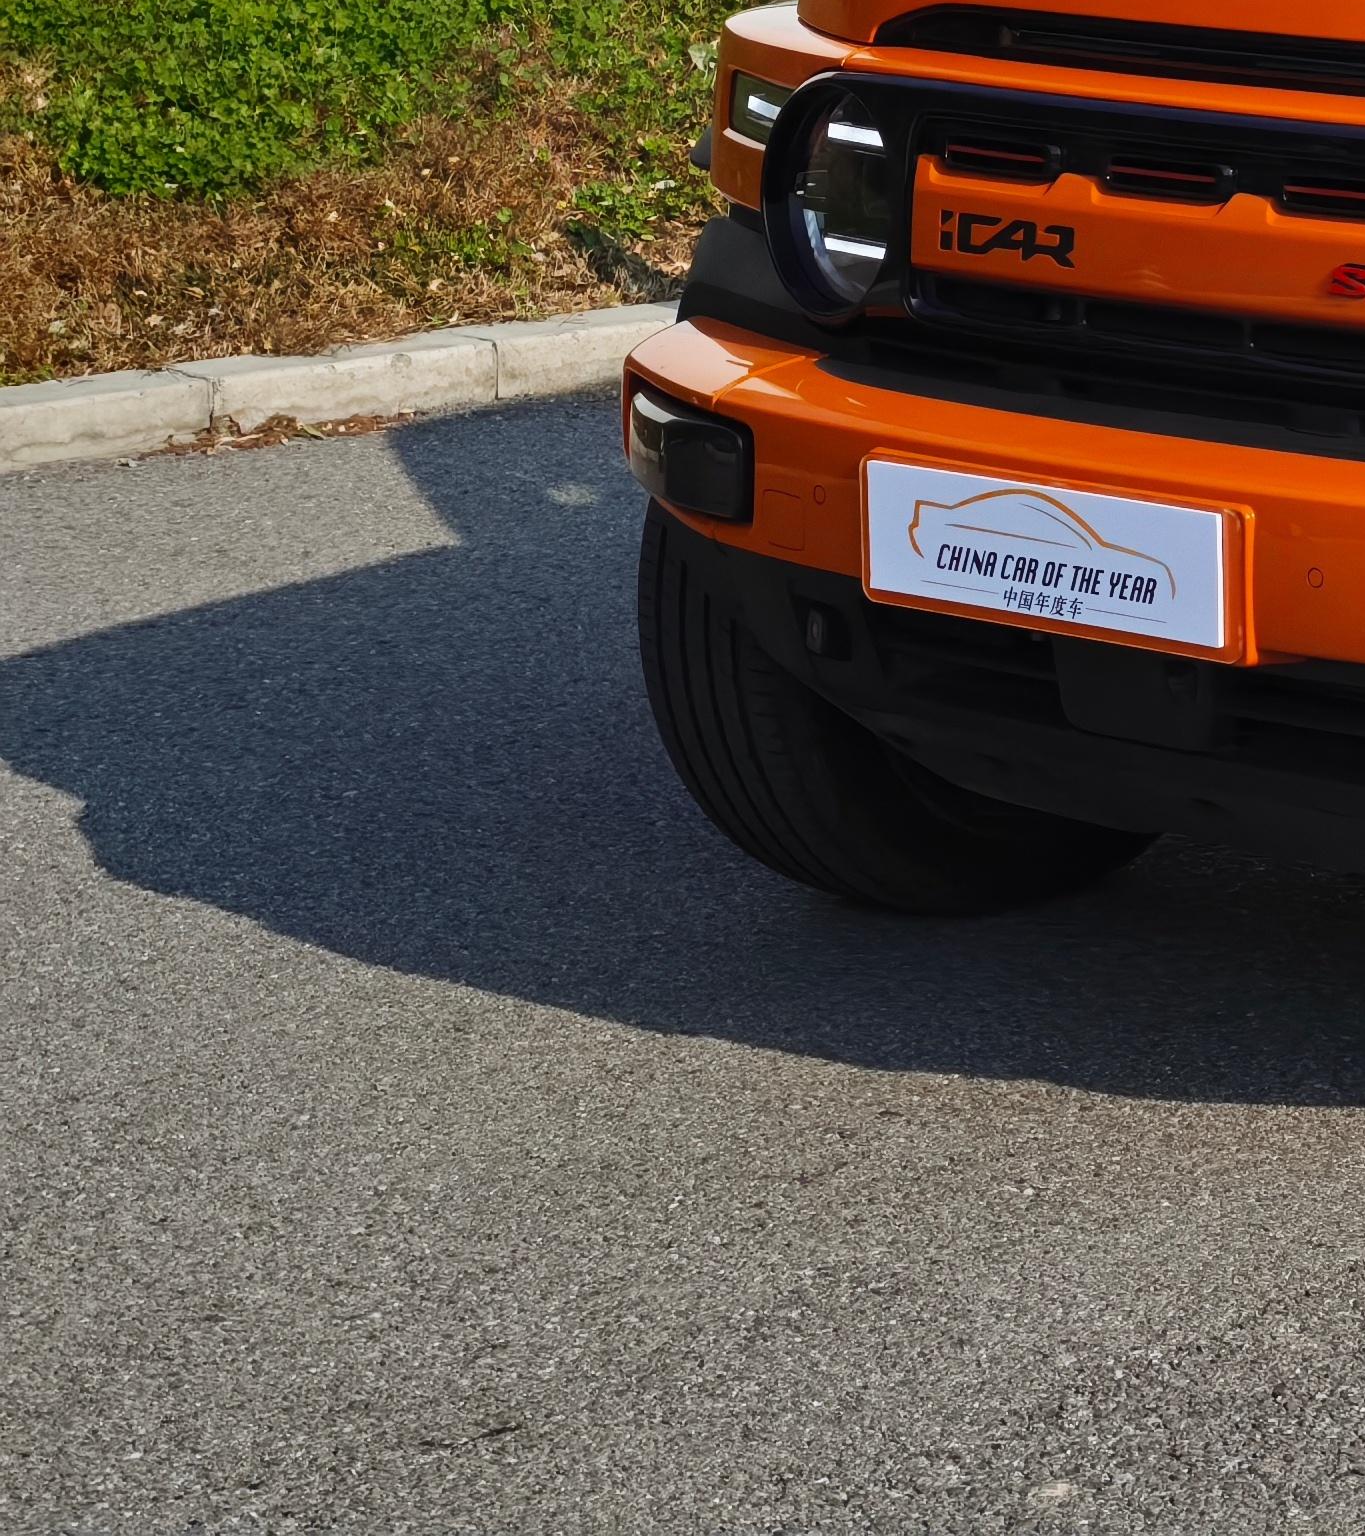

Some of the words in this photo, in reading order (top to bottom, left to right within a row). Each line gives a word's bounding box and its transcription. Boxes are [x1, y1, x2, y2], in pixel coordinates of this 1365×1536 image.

[936, 543, 998, 578] CHINA
[1000, 554, 1039, 585] CAR
[1041, 561, 1068, 589] OF
[1070, 565, 1105, 595] THE
[1109, 571, 1158, 605] YEAR
[1003, 585, 1084, 620] 中国年度车
